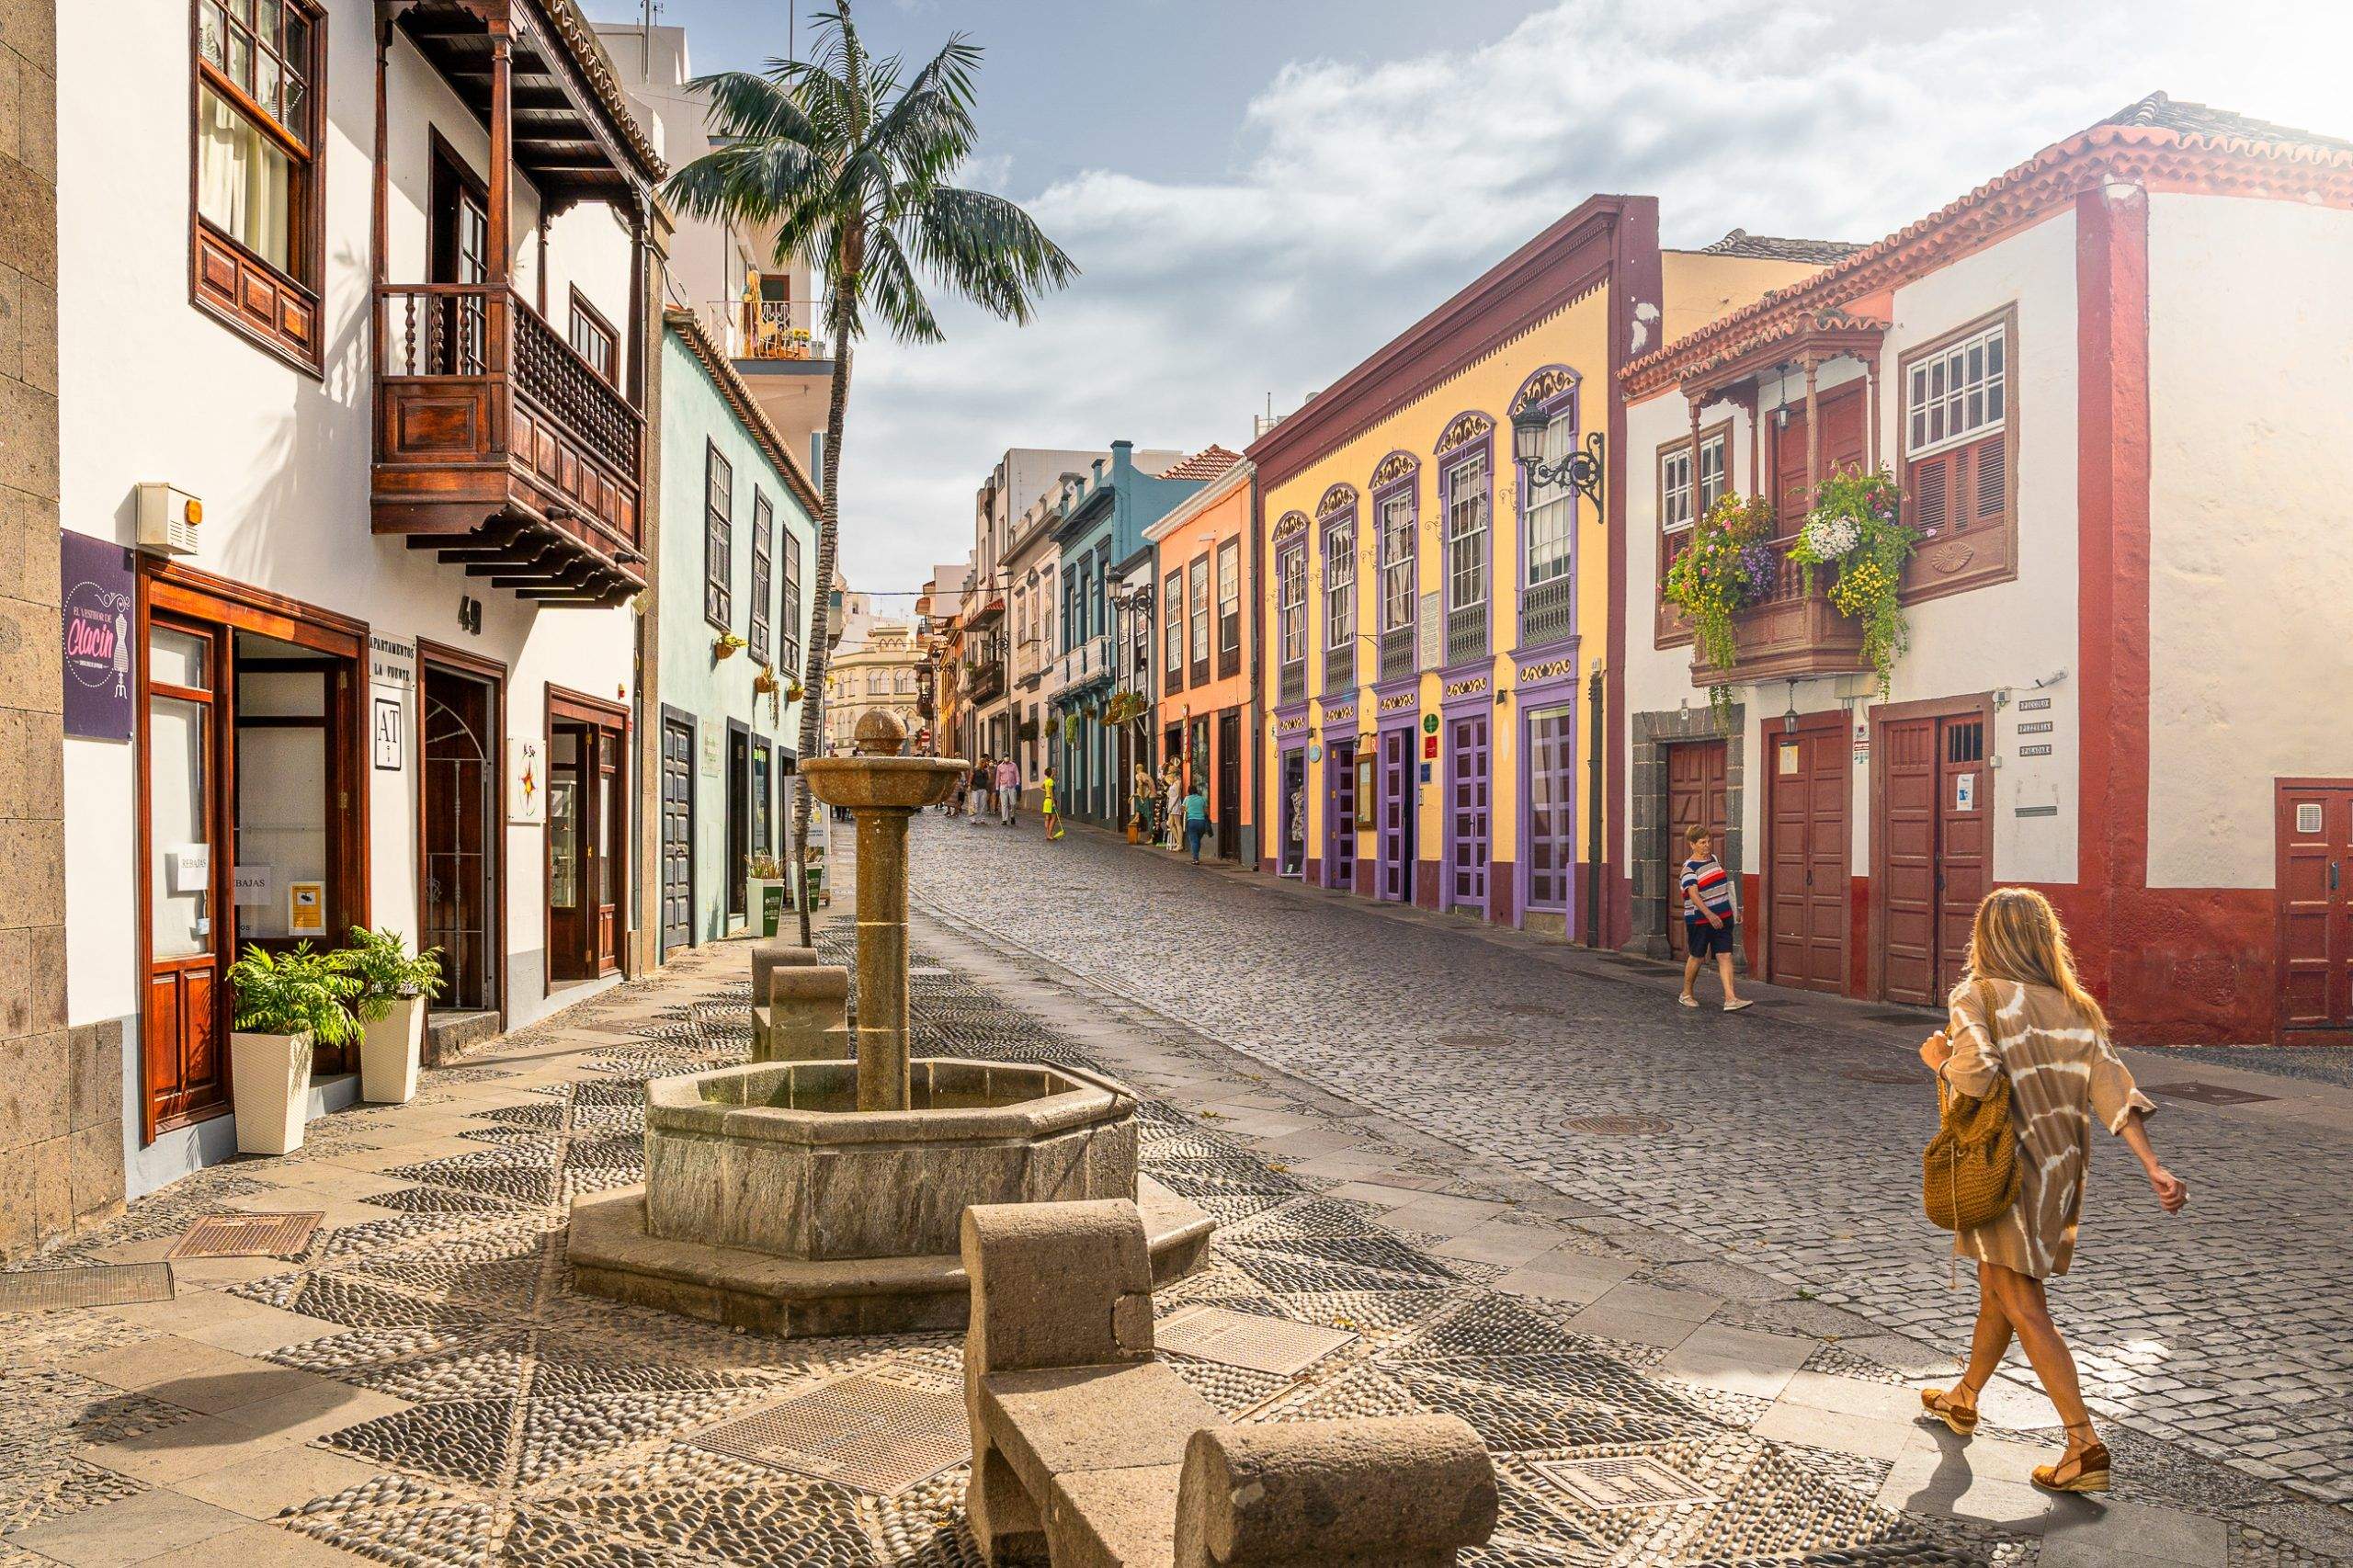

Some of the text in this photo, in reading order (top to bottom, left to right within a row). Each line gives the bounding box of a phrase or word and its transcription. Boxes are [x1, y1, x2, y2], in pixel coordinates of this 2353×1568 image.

[458, 596, 482, 635] 49
[369, 636, 414, 659] APARTAMENTOS
[374, 663, 410, 682] LA FUENTE
[378, 710, 399, 744] AT
[182, 858, 206, 868] REBAJAS
[235, 879, 265, 888] BAJAS
